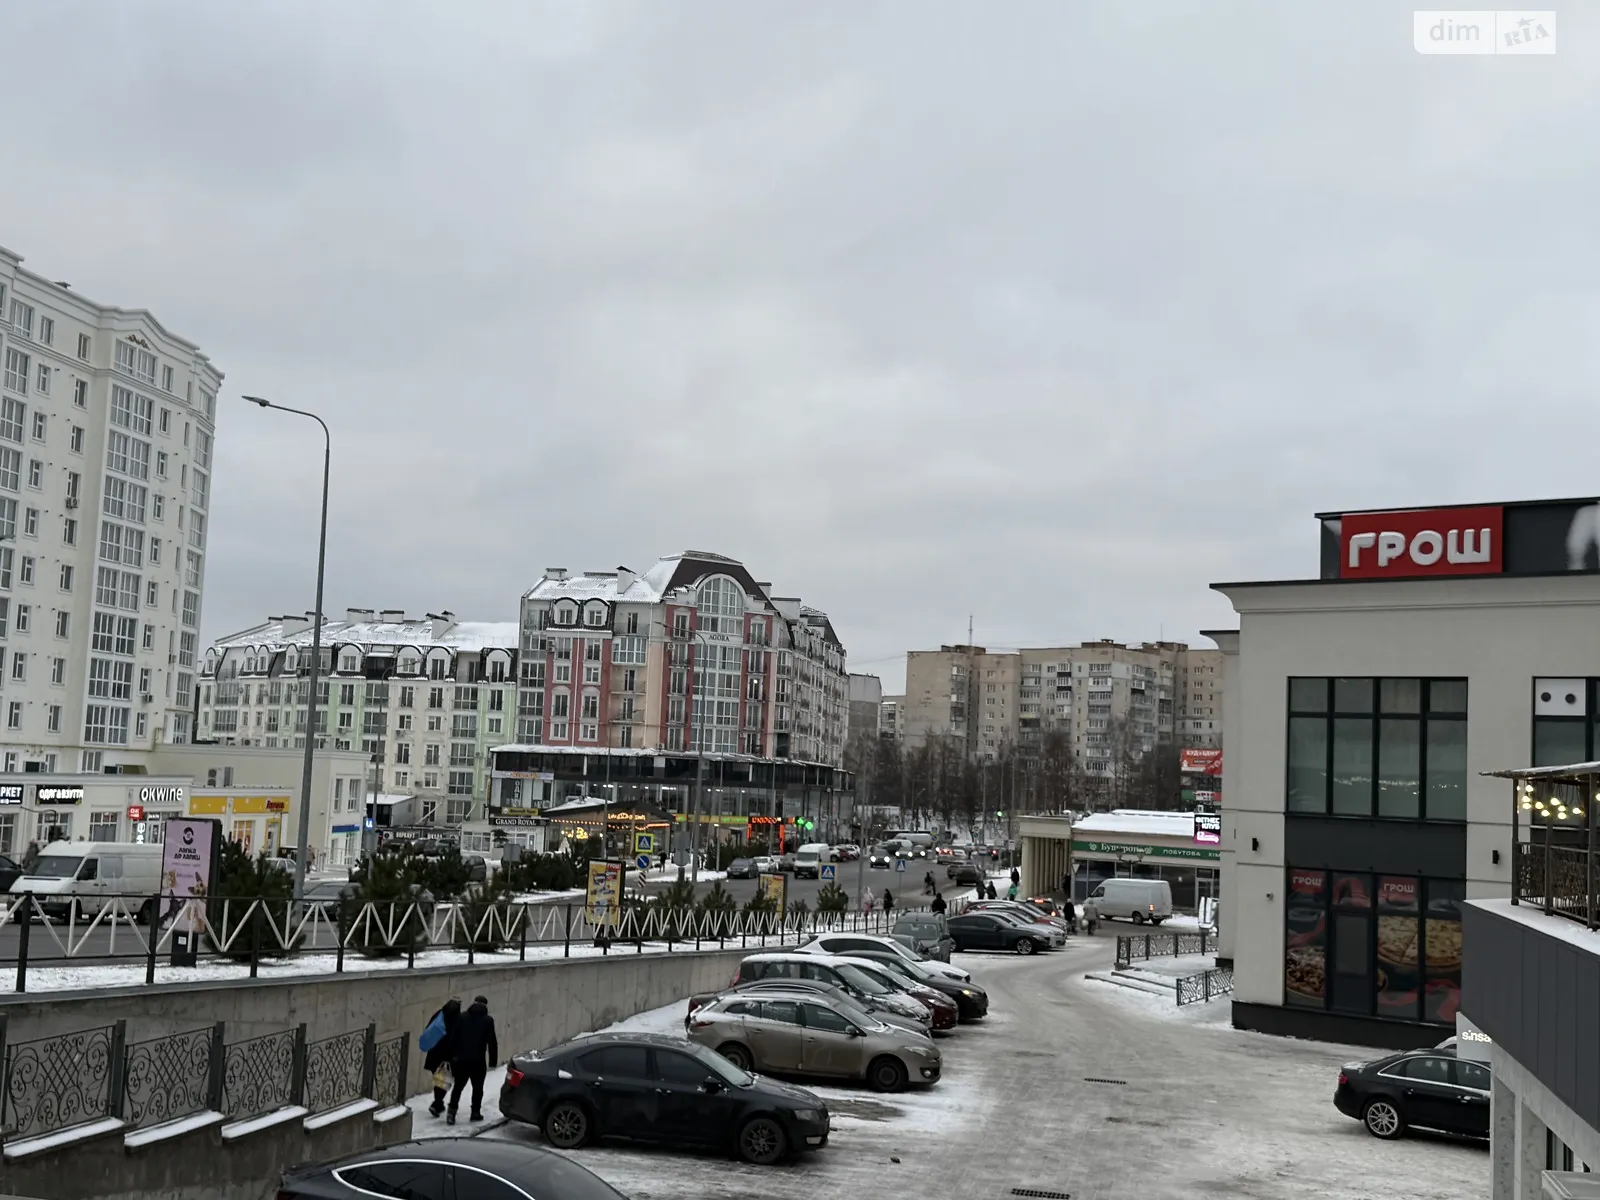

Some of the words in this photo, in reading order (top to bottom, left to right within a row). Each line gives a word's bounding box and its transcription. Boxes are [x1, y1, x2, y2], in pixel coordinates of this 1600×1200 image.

[1348, 528, 1491, 568] ГРОШ
[1163, 849, 1201, 857] ПОБУТОВА
[1292, 876, 1322, 886] ГРОШ
[1384, 883, 1414, 893] ГРОШ
[1461, 1029, 1493, 1044] sinsa
